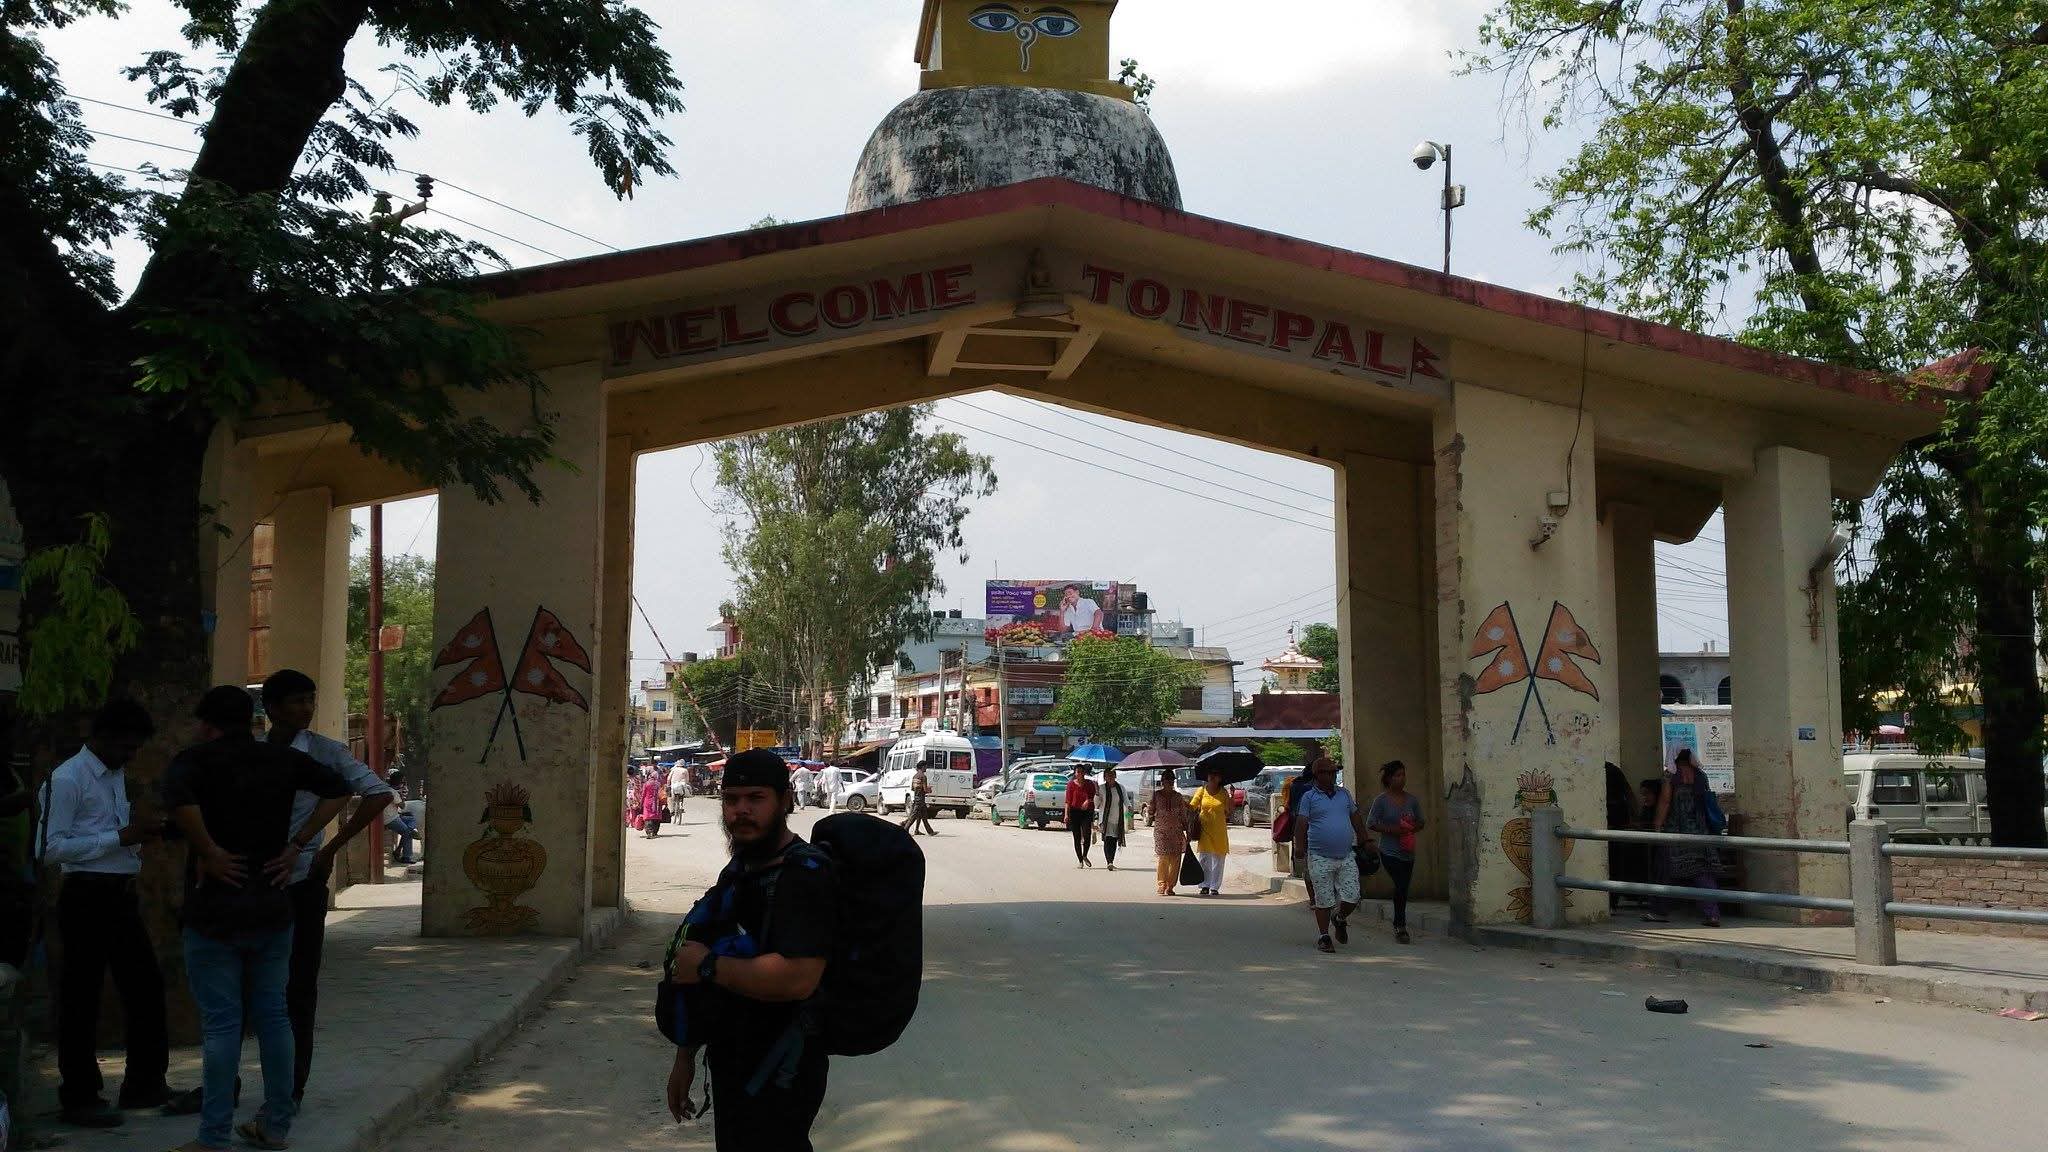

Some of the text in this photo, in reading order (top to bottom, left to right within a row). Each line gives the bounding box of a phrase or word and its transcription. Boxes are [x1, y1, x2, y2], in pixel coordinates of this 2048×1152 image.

[609, 263, 1407, 379] WELCOME TO NEPAL
